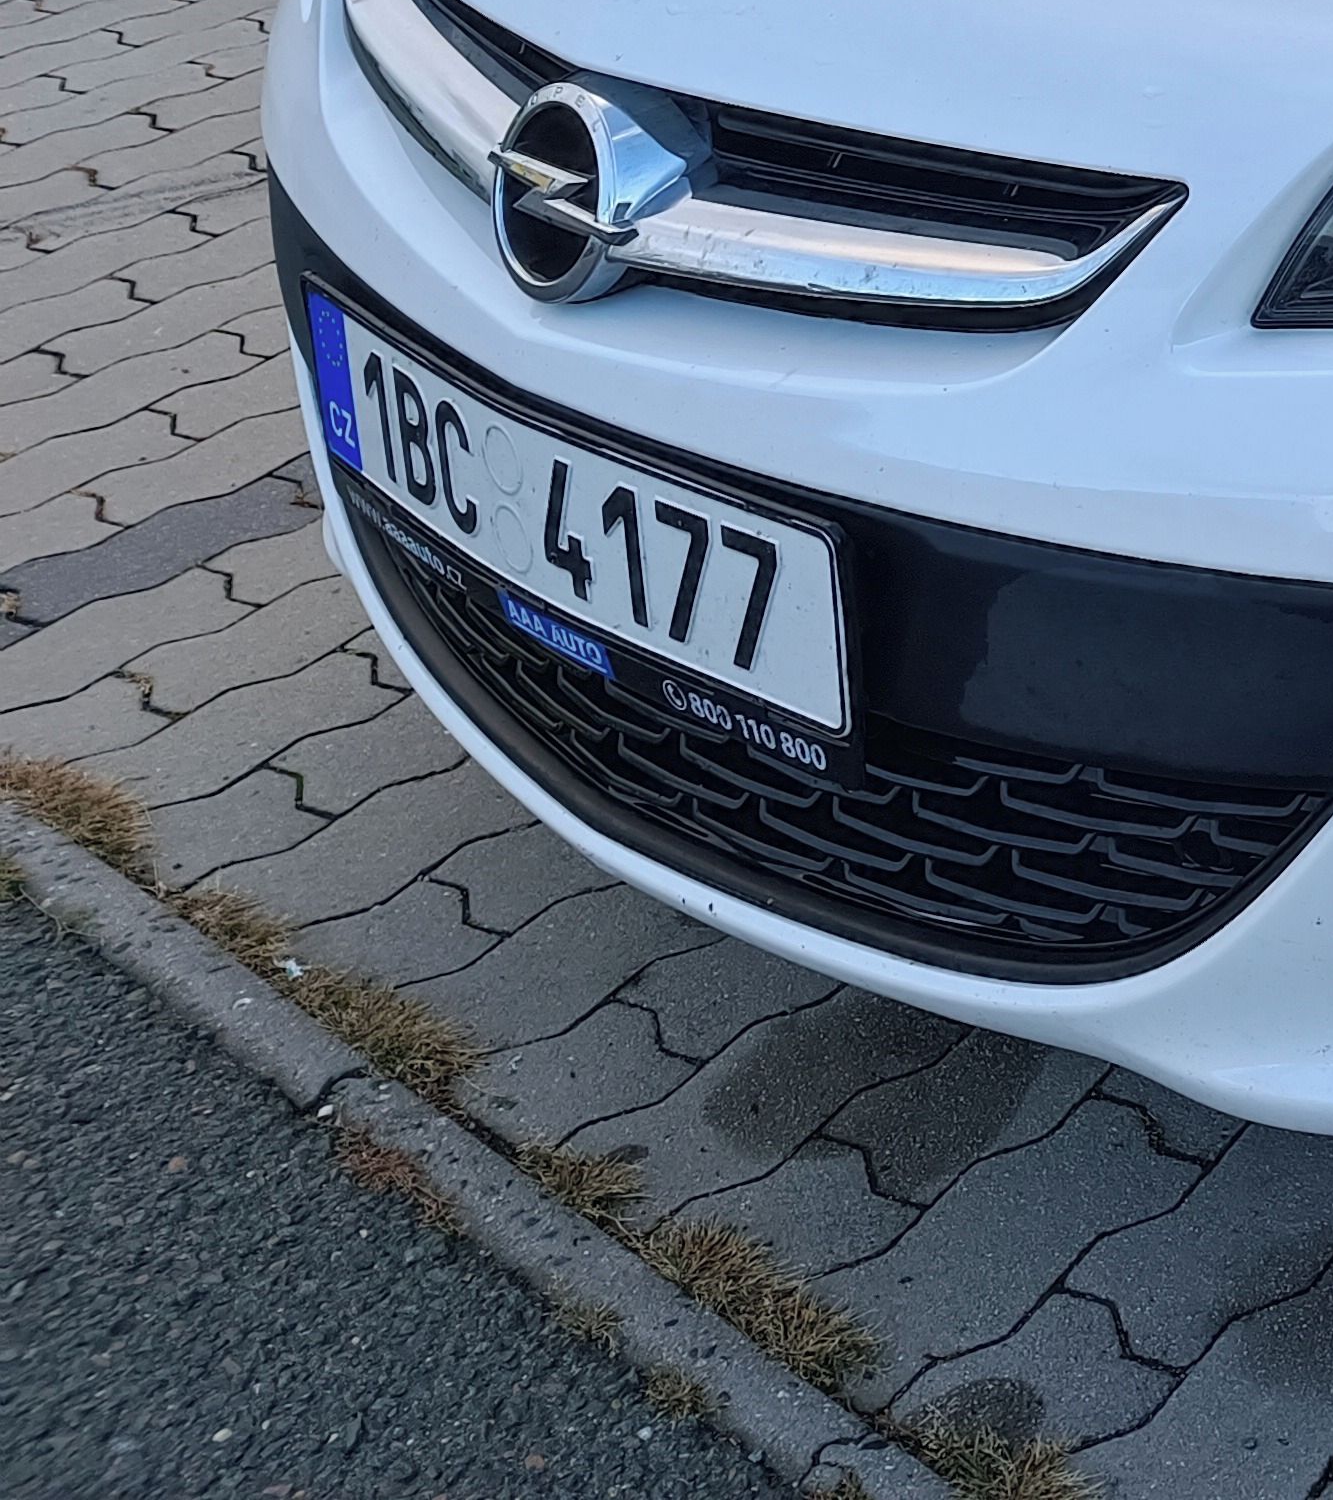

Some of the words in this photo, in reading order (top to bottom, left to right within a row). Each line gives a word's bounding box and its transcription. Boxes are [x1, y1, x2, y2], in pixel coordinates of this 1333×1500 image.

[529, 85, 602, 134] OPEL
[328, 399, 357, 449] CZ
[363, 351, 478, 536] 1BC
[543, 458, 778, 672] 4177
[508, 599, 546, 638] AAA
[550, 625, 601, 664] AUTO
[687, 691, 733, 731] 800
[734, 713, 777, 750] 110
[779, 731, 827, 771] 800
